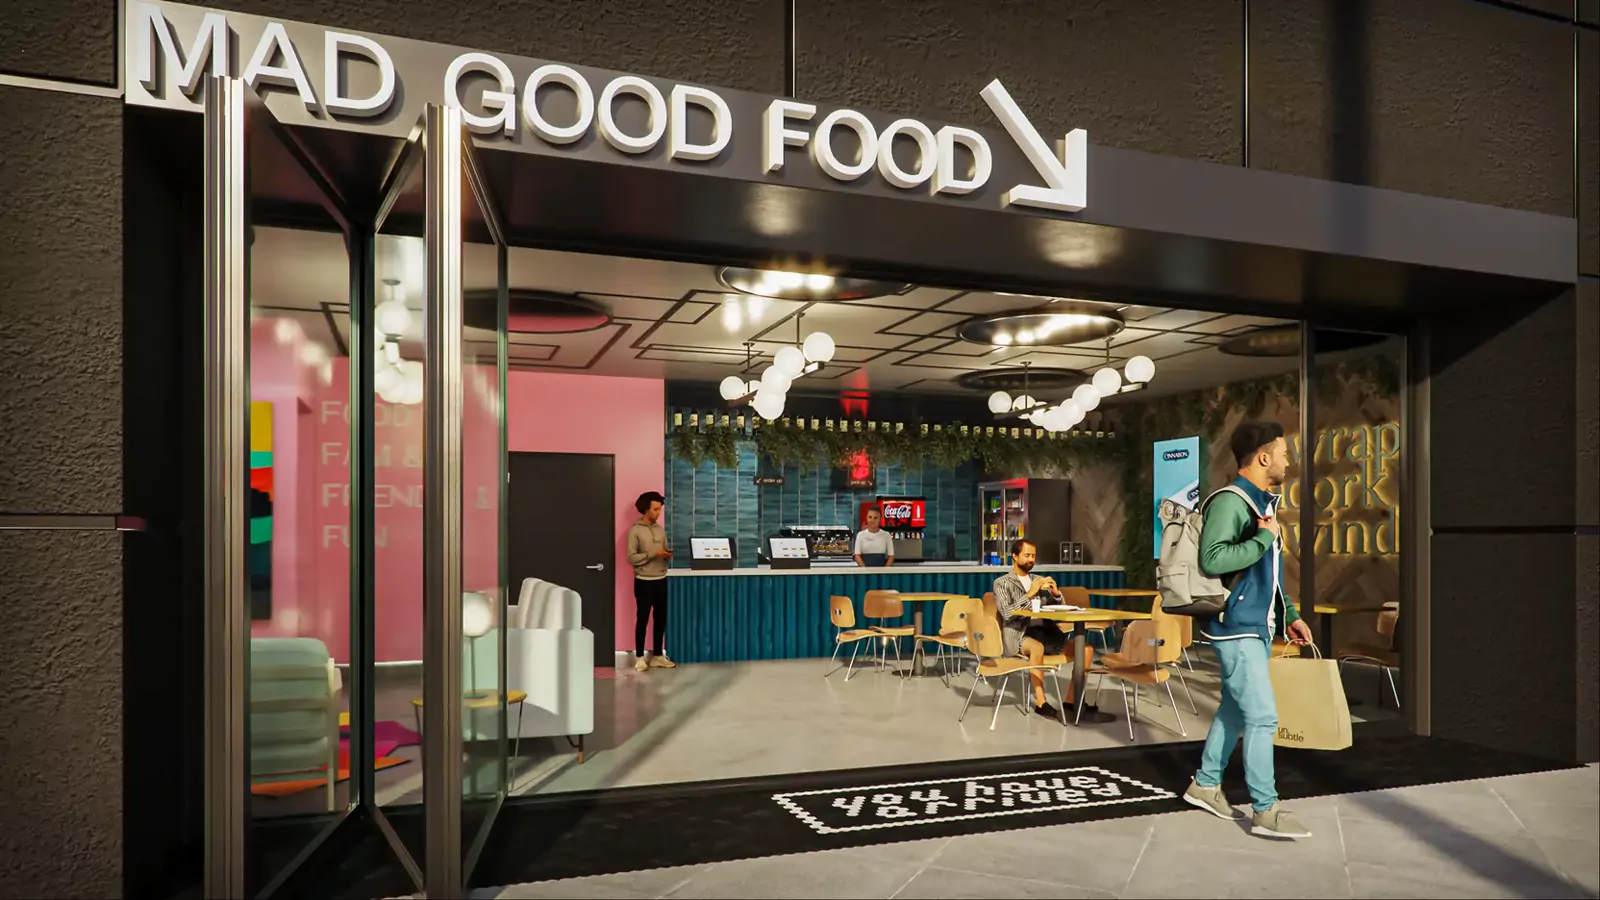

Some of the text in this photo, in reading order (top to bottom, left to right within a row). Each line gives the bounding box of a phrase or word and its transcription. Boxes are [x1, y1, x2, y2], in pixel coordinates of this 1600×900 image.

[139, 4, 993, 196] MAD GOOD FOOD
[321, 400, 414, 427] FOD
